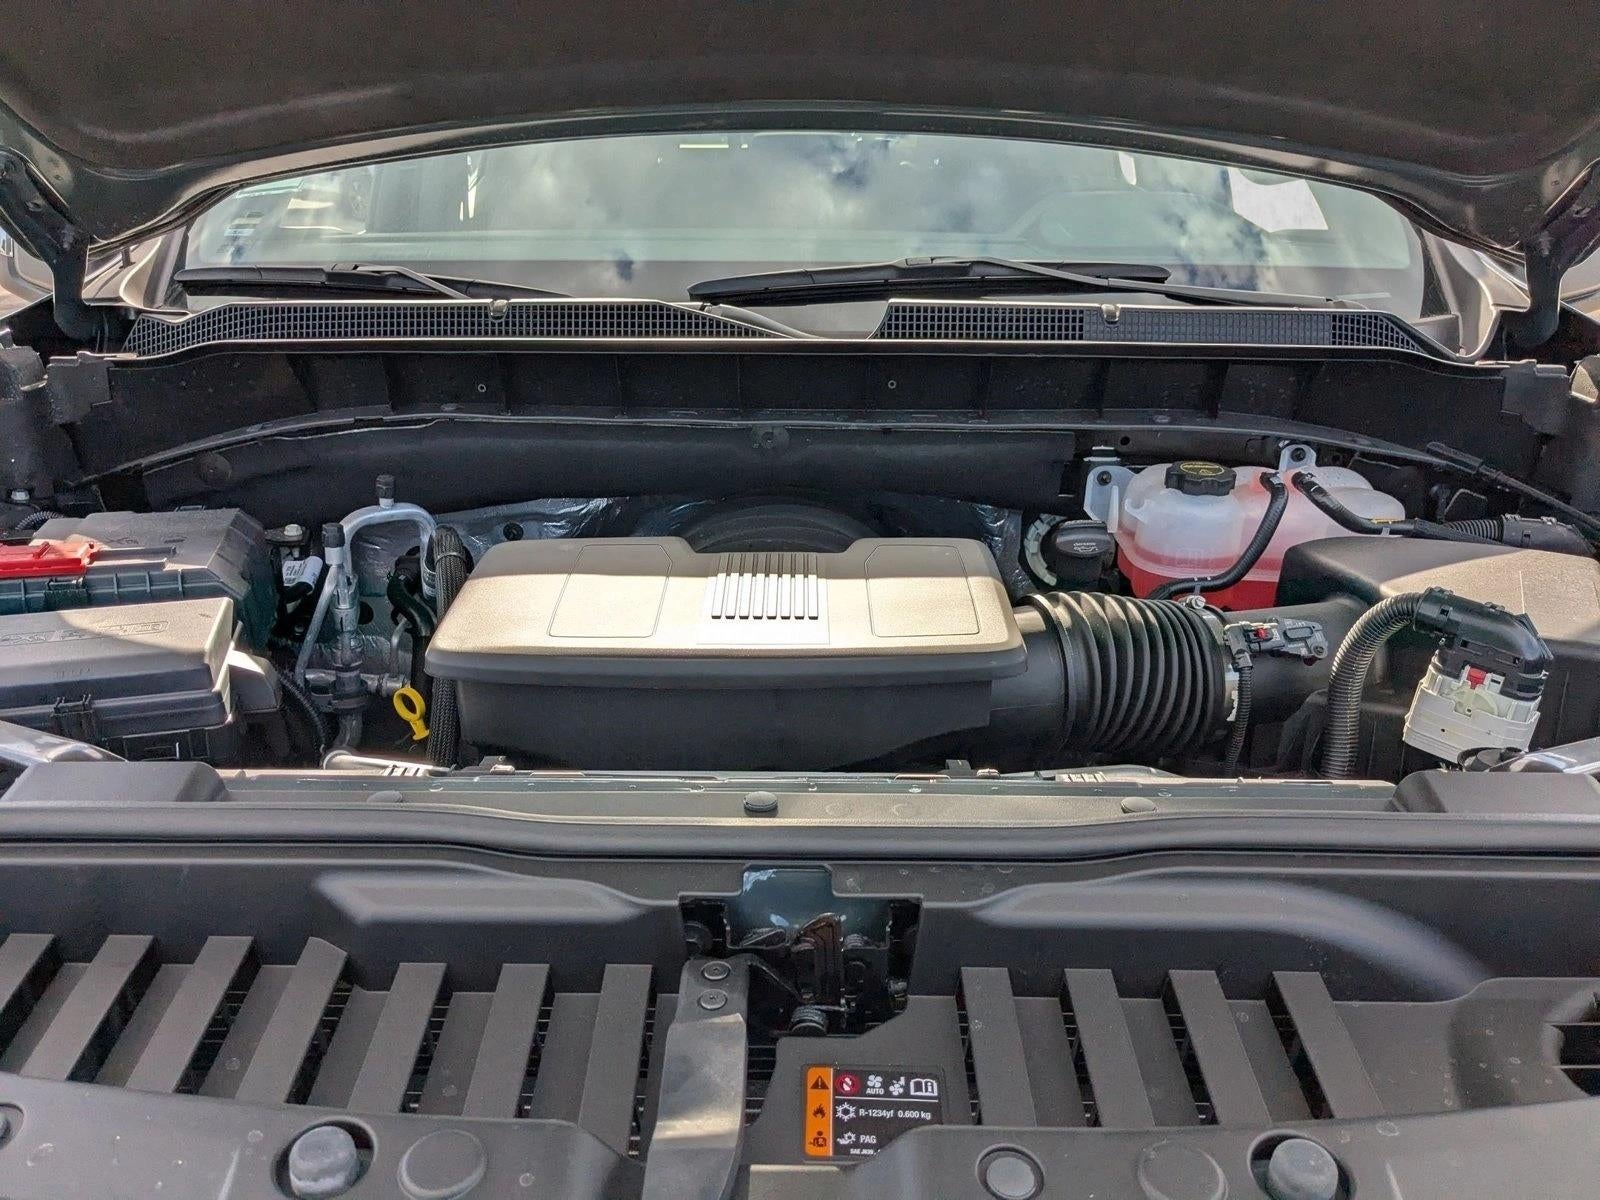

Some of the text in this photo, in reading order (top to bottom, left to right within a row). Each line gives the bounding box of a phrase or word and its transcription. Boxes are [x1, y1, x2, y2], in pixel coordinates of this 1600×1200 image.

[865, 1087, 885, 1095] AUTO
[859, 1108, 931, 1120] R-1234yf 0.600 kg
[860, 1134, 877, 1144] PAG
